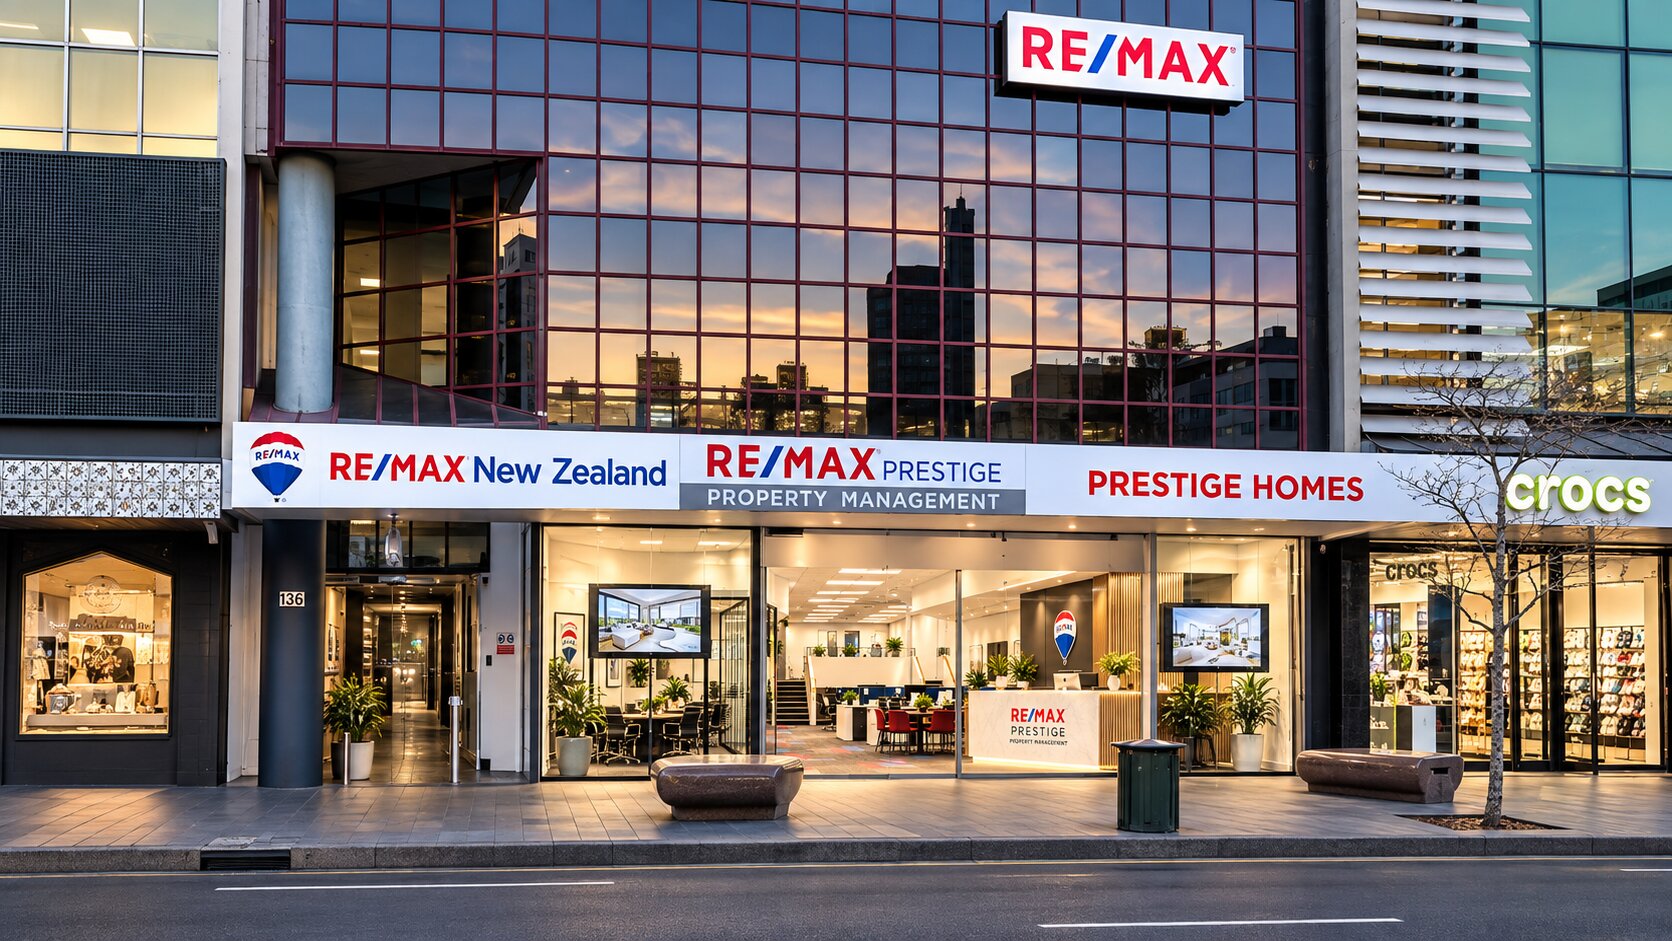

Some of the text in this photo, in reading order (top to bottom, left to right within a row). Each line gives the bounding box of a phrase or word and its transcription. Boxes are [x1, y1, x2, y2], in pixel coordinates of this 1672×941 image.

[1022, 25, 1230, 87] RE/MAX
[255, 448, 300, 462] RE/MAX
[706, 443, 1002, 483] RE/MAX PRESTIGE
[329, 452, 667, 487] RE/MAX New Zealand
[1088, 469, 1364, 502] PRESTIGE HOMES
[1505, 473, 1652, 514] crocs
[707, 488, 1000, 510] PROPERTY MANAGEMENT
[1385, 561, 1438, 580] crocs
[280, 592, 304, 606] 136
[1011, 708, 1065, 723] RE/MAX
[1011, 726, 1065, 737] PRESTIGE
